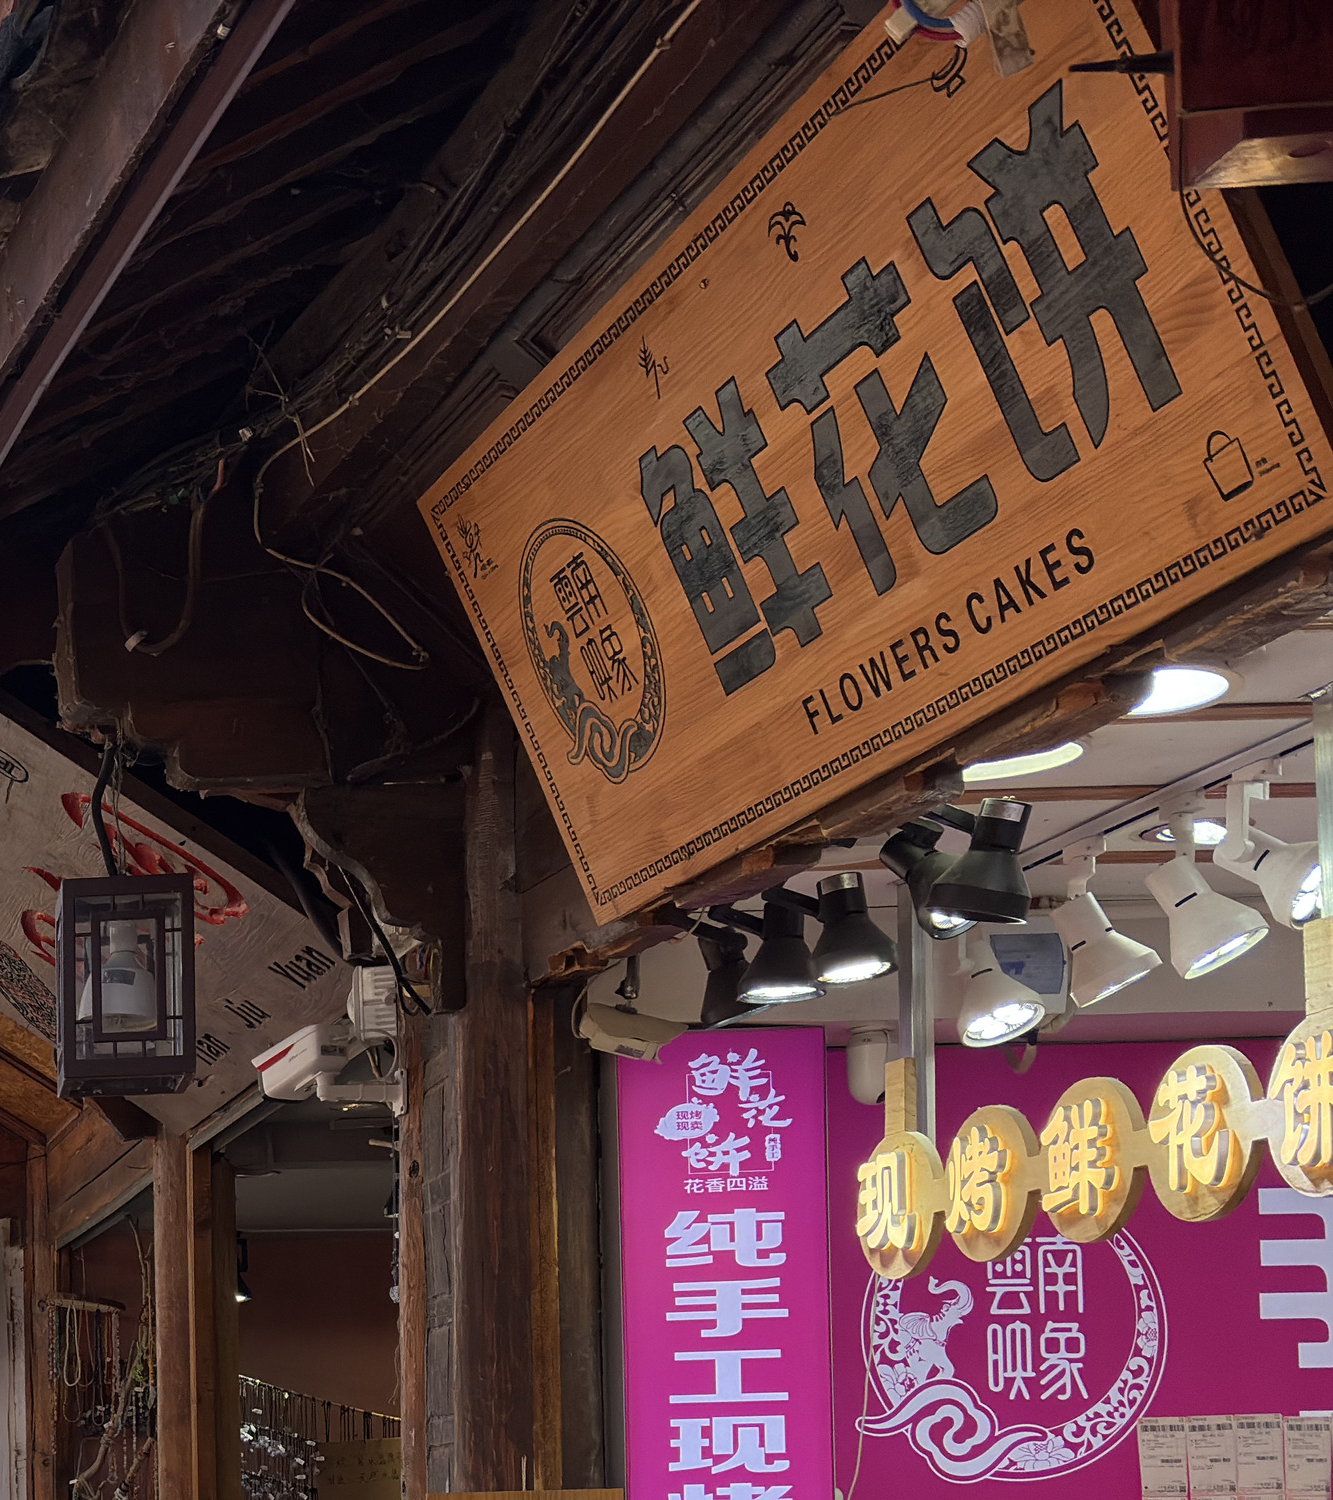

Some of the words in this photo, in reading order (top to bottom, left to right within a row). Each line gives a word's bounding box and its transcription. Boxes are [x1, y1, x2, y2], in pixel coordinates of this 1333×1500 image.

[639, 78, 1183, 696] 鲜花饼
[802, 611, 961, 735] FLOWERS
[964, 527, 1097, 637] CAKES
[224, 998, 272, 1029] Jiu
[268, 945, 336, 990] Yuan
[675, 1109, 702, 1120] 现烤
[675, 1120, 703, 1131] 现卖
[855, 1029, 1333, 1250] 现烤鲜花饼
[683, 1176, 769, 1194] 花香四溢
[987, 1320, 1089, 1401] 映象
